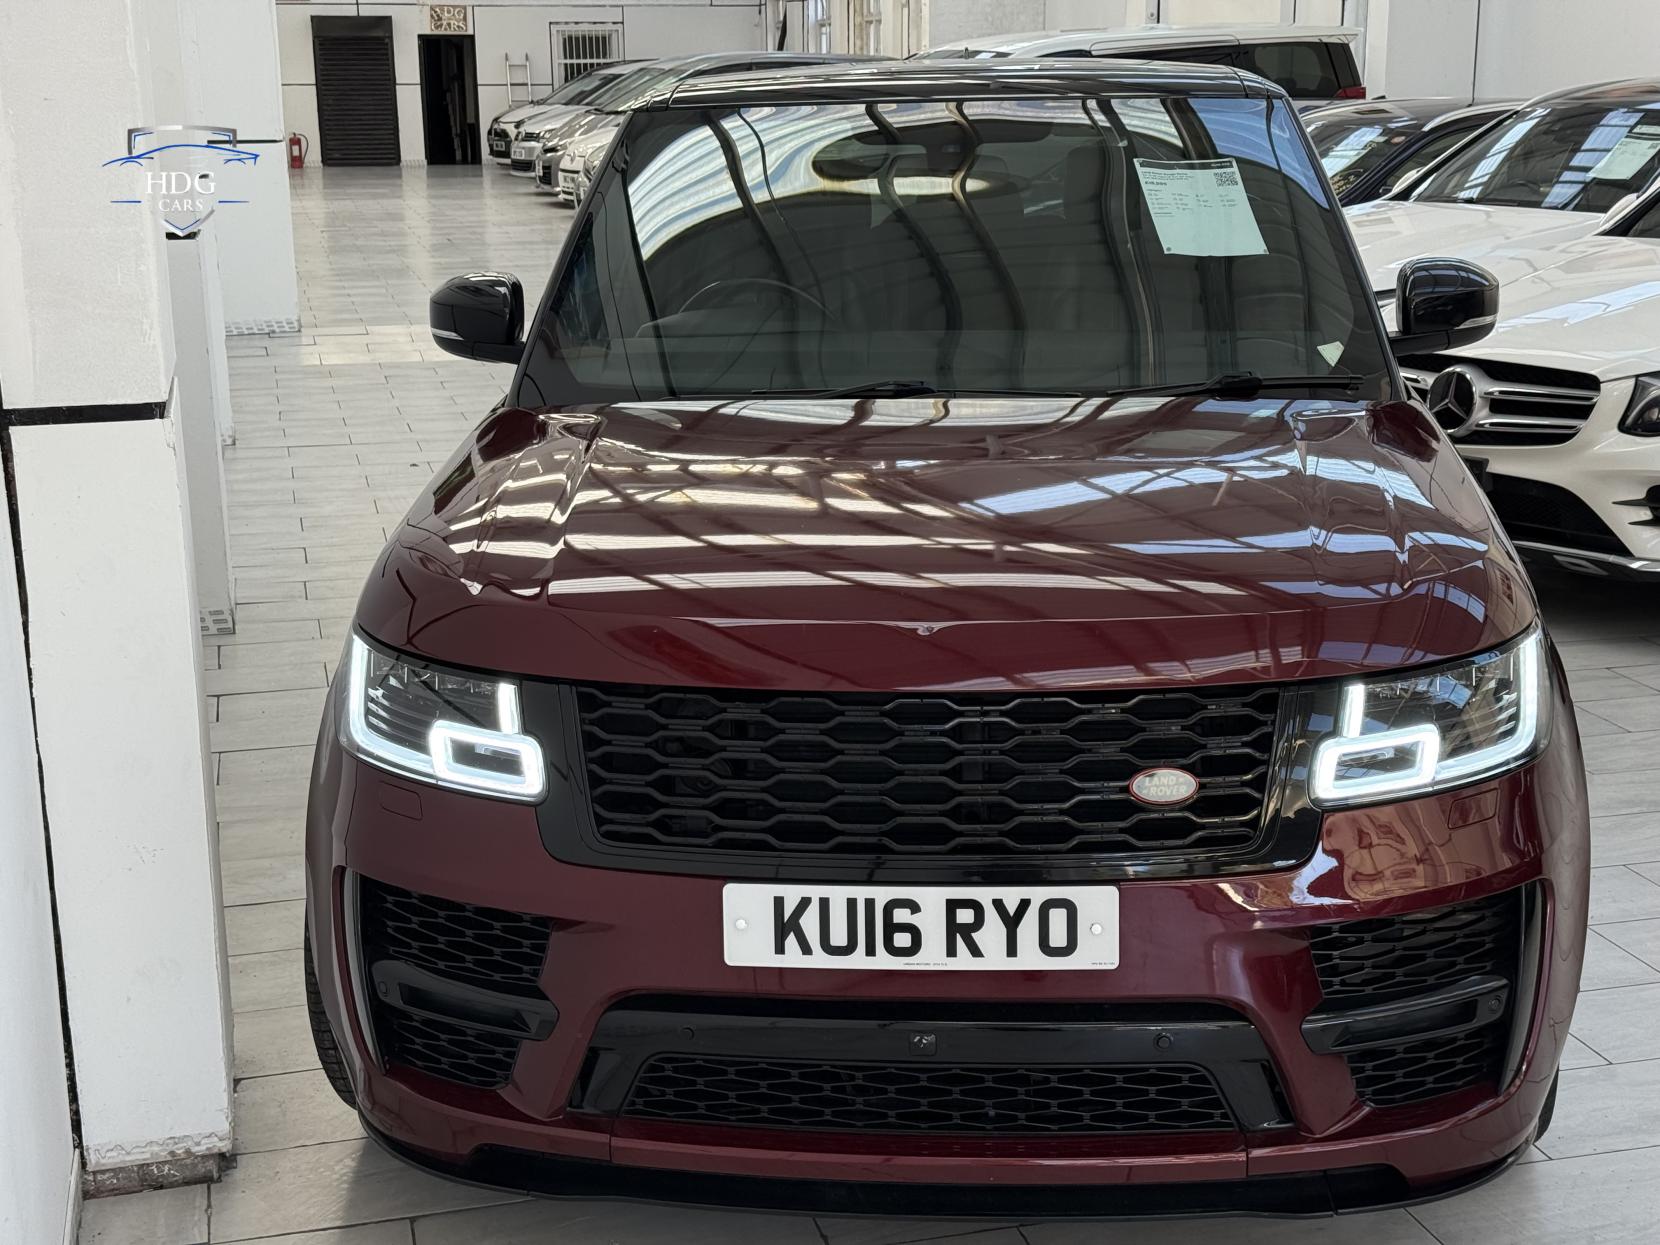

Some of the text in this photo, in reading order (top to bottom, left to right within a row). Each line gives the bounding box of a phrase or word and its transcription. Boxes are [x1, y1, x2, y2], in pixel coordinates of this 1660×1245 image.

[431, 20, 466, 31] CARS
[1145, 775, 1177, 786] LAND
[1149, 785, 1187, 797] ROVER
[773, 896, 1078, 958] KU16 RYO
